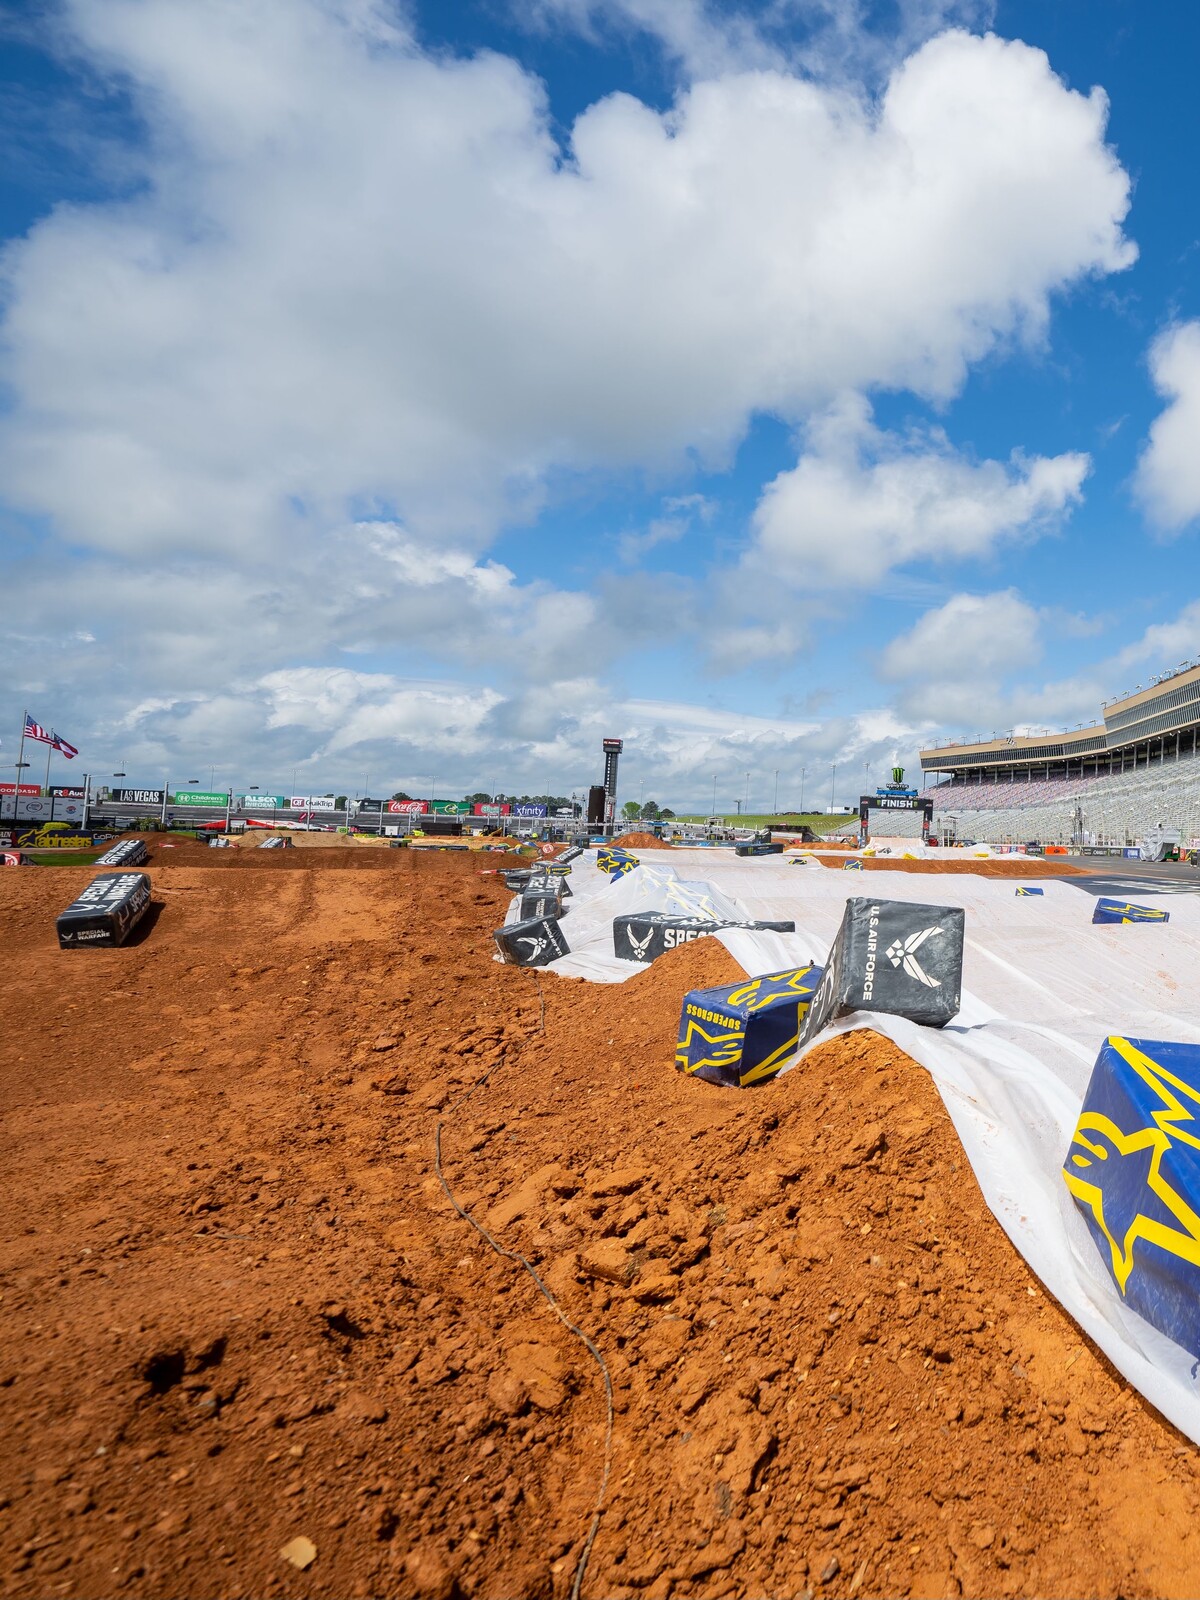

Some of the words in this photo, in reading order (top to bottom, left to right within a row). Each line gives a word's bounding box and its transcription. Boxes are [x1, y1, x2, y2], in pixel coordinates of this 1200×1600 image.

[0, 787, 37, 795] OORDASH
[120, 790, 134, 802] LAS
[134, 790, 160, 803] VEGAS
[881, 799, 913, 808] FINISH
[516, 805, 544, 816] xfinity
[37, 834, 92, 848] alpinestars
[870, 905, 880, 928] U.S.
[77, 928, 106, 936] SPECIAL
[78, 931, 111, 941] WARFARE
[868, 929, 878, 952] AIR
[862, 953, 876, 1001] FORCE
[686, 1003, 741, 1031] SUPERCROSS
